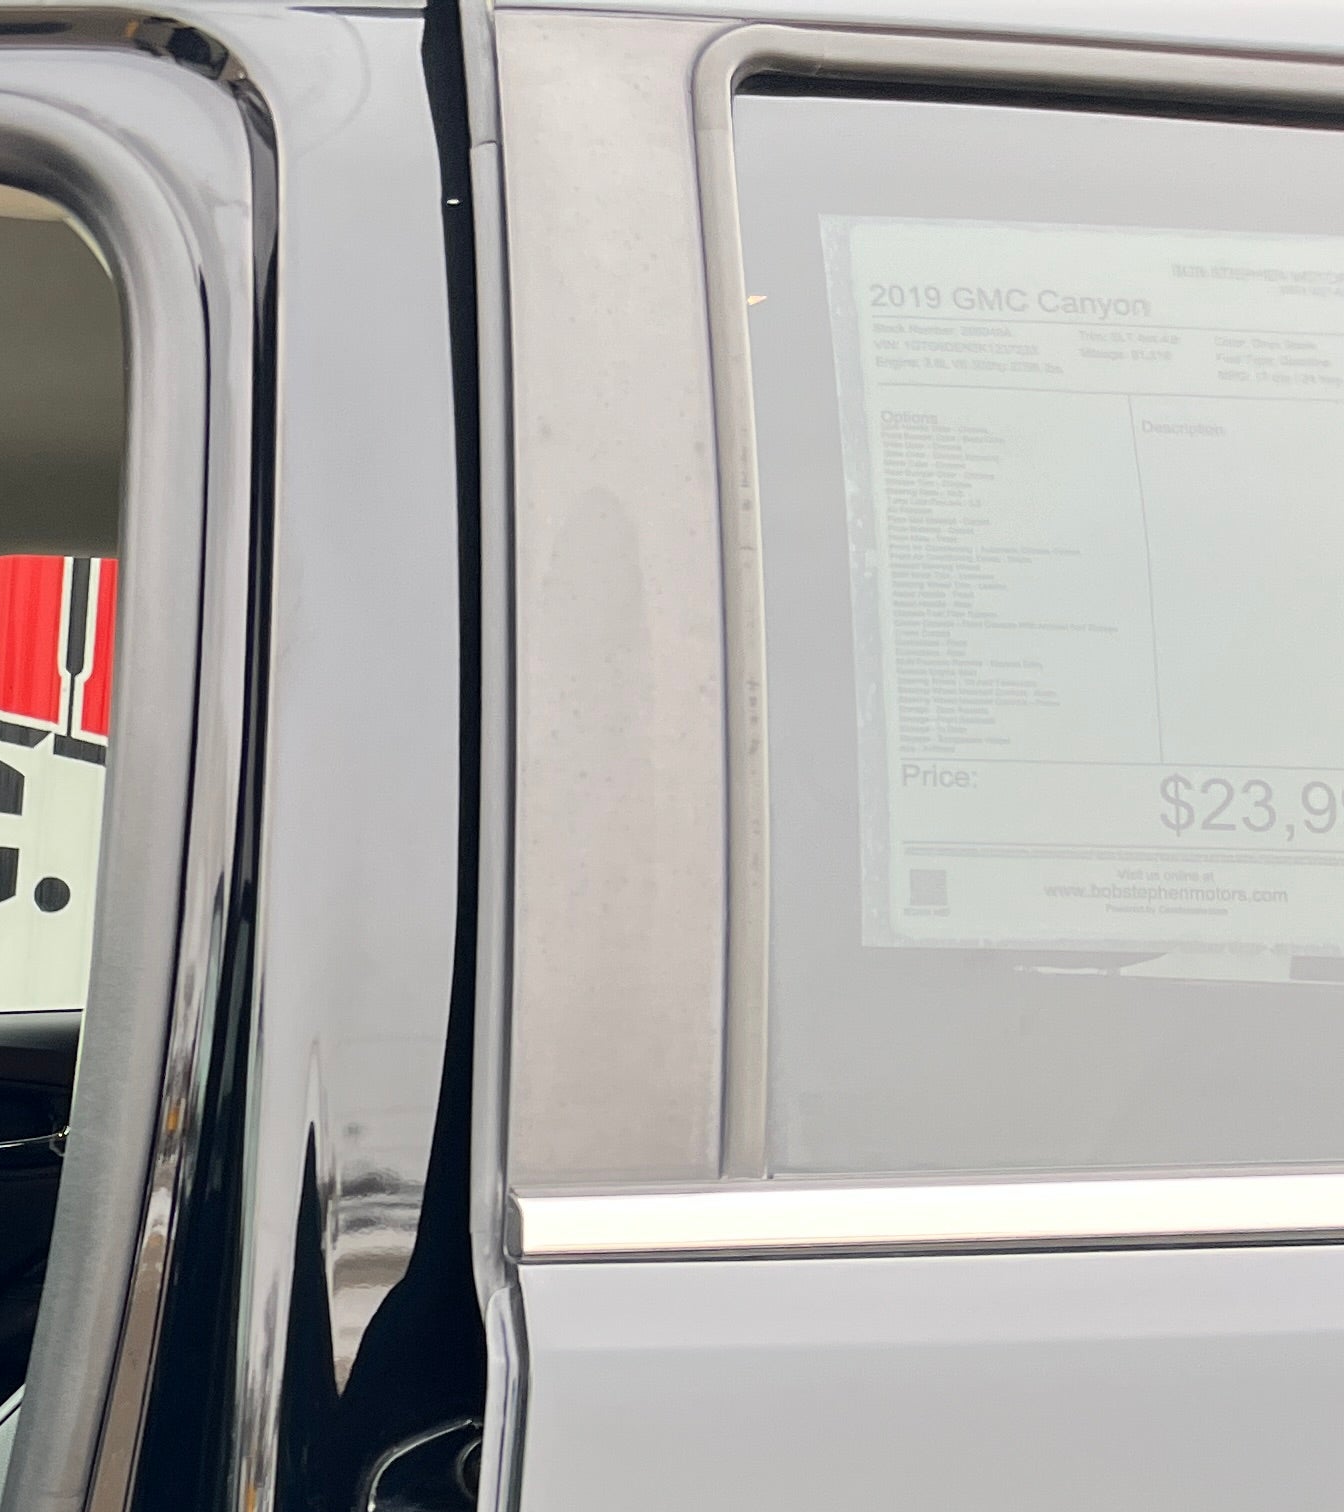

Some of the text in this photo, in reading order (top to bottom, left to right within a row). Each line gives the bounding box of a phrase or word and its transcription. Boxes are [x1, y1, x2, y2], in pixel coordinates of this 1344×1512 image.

[869, 283, 1151, 320] 2019 GMC Canyon
[901, 763, 979, 790] Price:
[1159, 772, 1344, 842] $23,9
